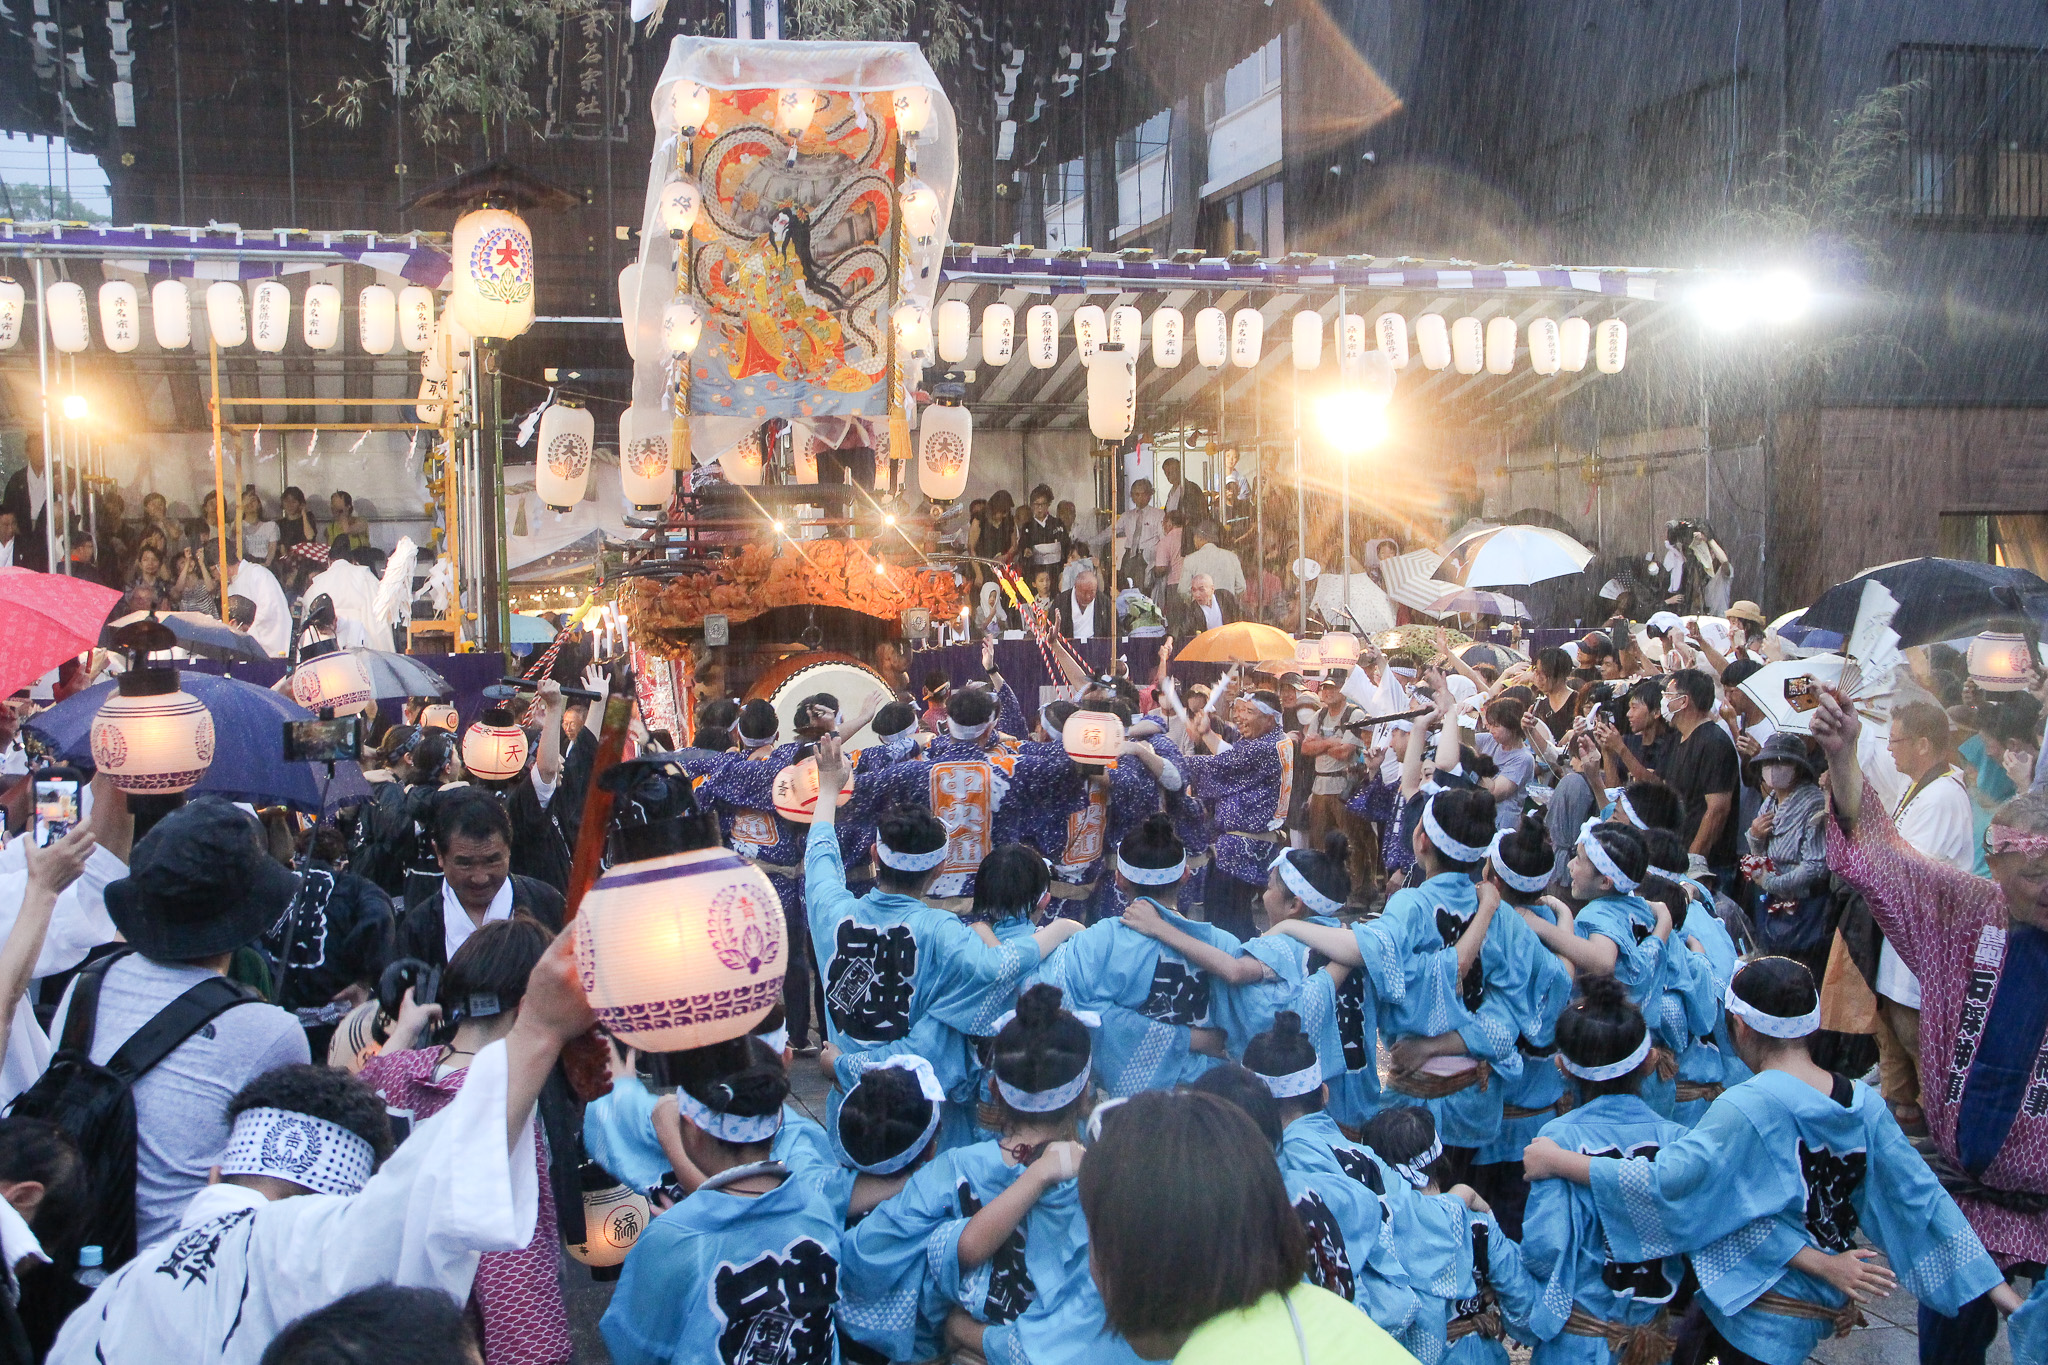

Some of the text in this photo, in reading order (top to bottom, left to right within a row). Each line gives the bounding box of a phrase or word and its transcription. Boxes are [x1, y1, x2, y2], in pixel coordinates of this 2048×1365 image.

[495, 239, 520, 268] 大
[114, 296, 129, 340] 桑名宗社
[260, 287, 271, 339] 石取祭保存会
[309, 298, 321, 336] 桑名宗社
[416, 302, 429, 341] 桑名宗社
[1041, 311, 1055, 360] 石取祭保存会
[1165, 320, 1176, 356] 桑名宗社
[1237, 319, 1250, 355] 桑名宗社
[562, 440, 578, 457] 大
[937, 438, 953, 454] 大
[504, 744, 523, 763] 天
